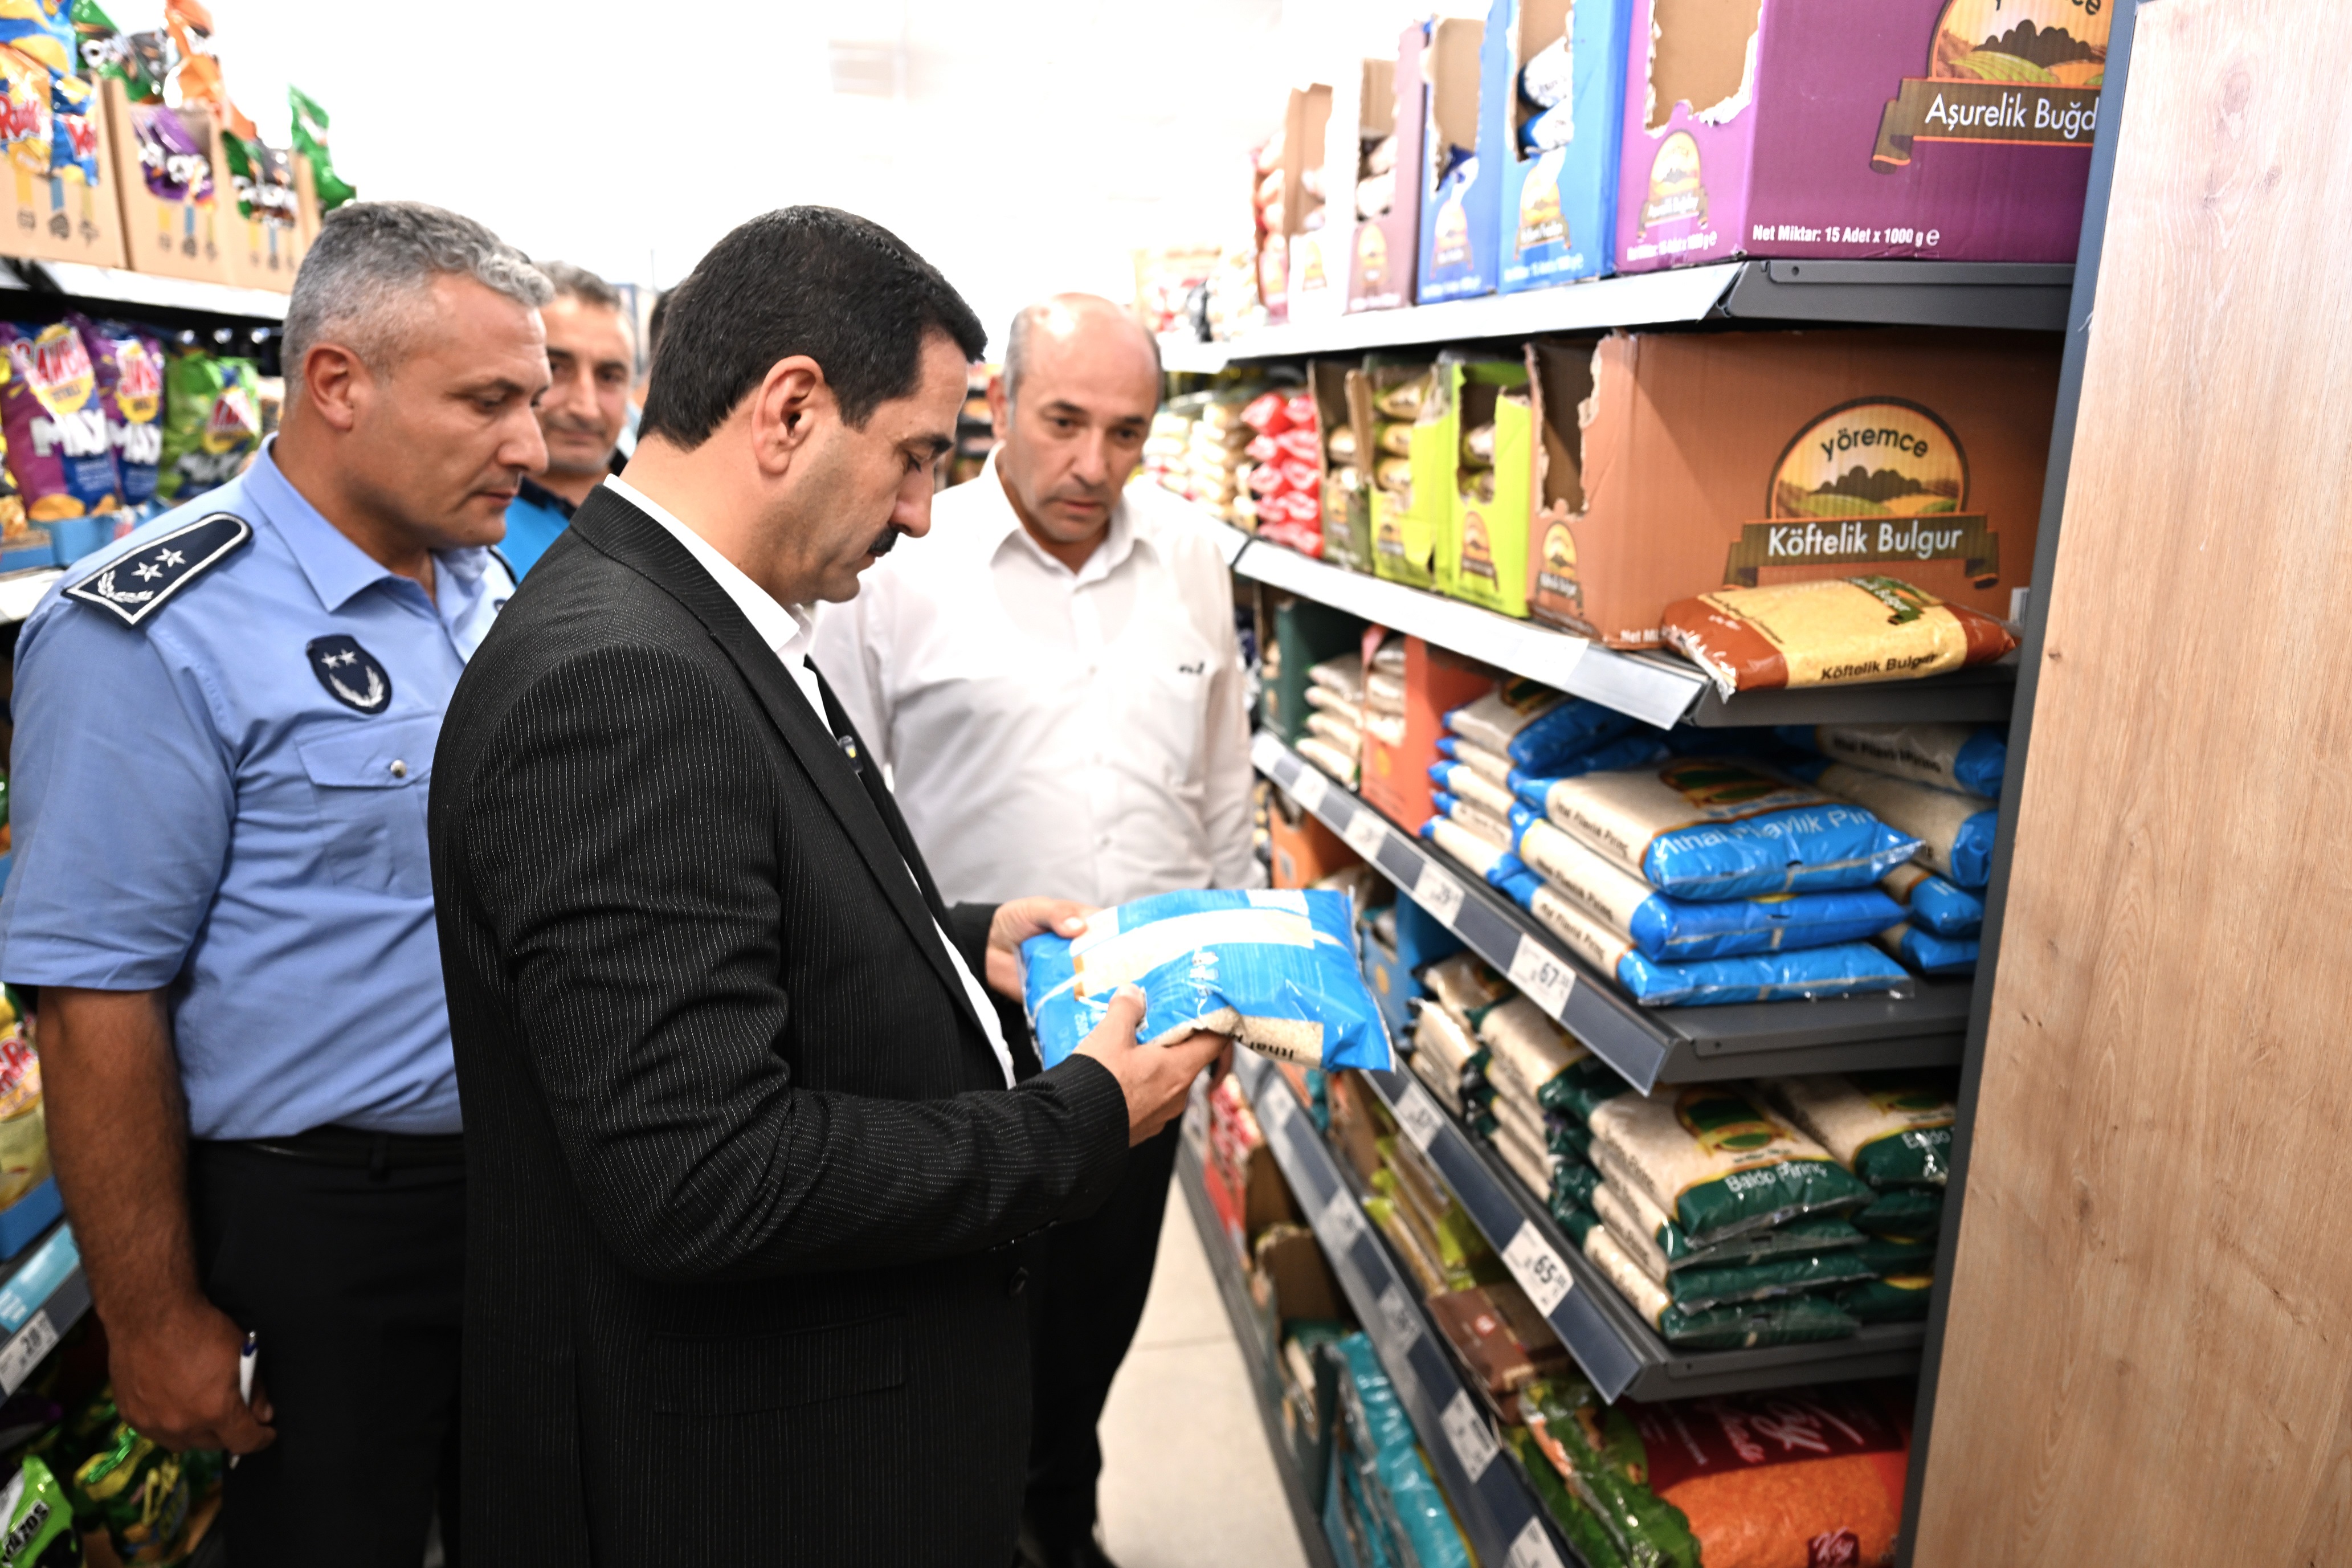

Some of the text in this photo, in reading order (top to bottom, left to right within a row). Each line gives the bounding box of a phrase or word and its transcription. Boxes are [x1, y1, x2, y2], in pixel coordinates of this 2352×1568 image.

[1925, 92, 2028, 131] Aşurelik
[1753, 224, 1775, 240] Net
[1778, 226, 1822, 242] Miktar:
[1824, 226, 1840, 242] 15
[1841, 227, 1872, 243] Adet
[1883, 227, 1914, 246] 1000
[1915, 231, 1924, 247] g
[1820, 428, 1929, 462] yöremce
[1768, 519, 1963, 560] Köftelik Bulgur
[1820, 660, 1881, 680] Köftelik
[1724, 1170, 1777, 1193] Baldo
[1534, 1255, 1558, 1284] 65
